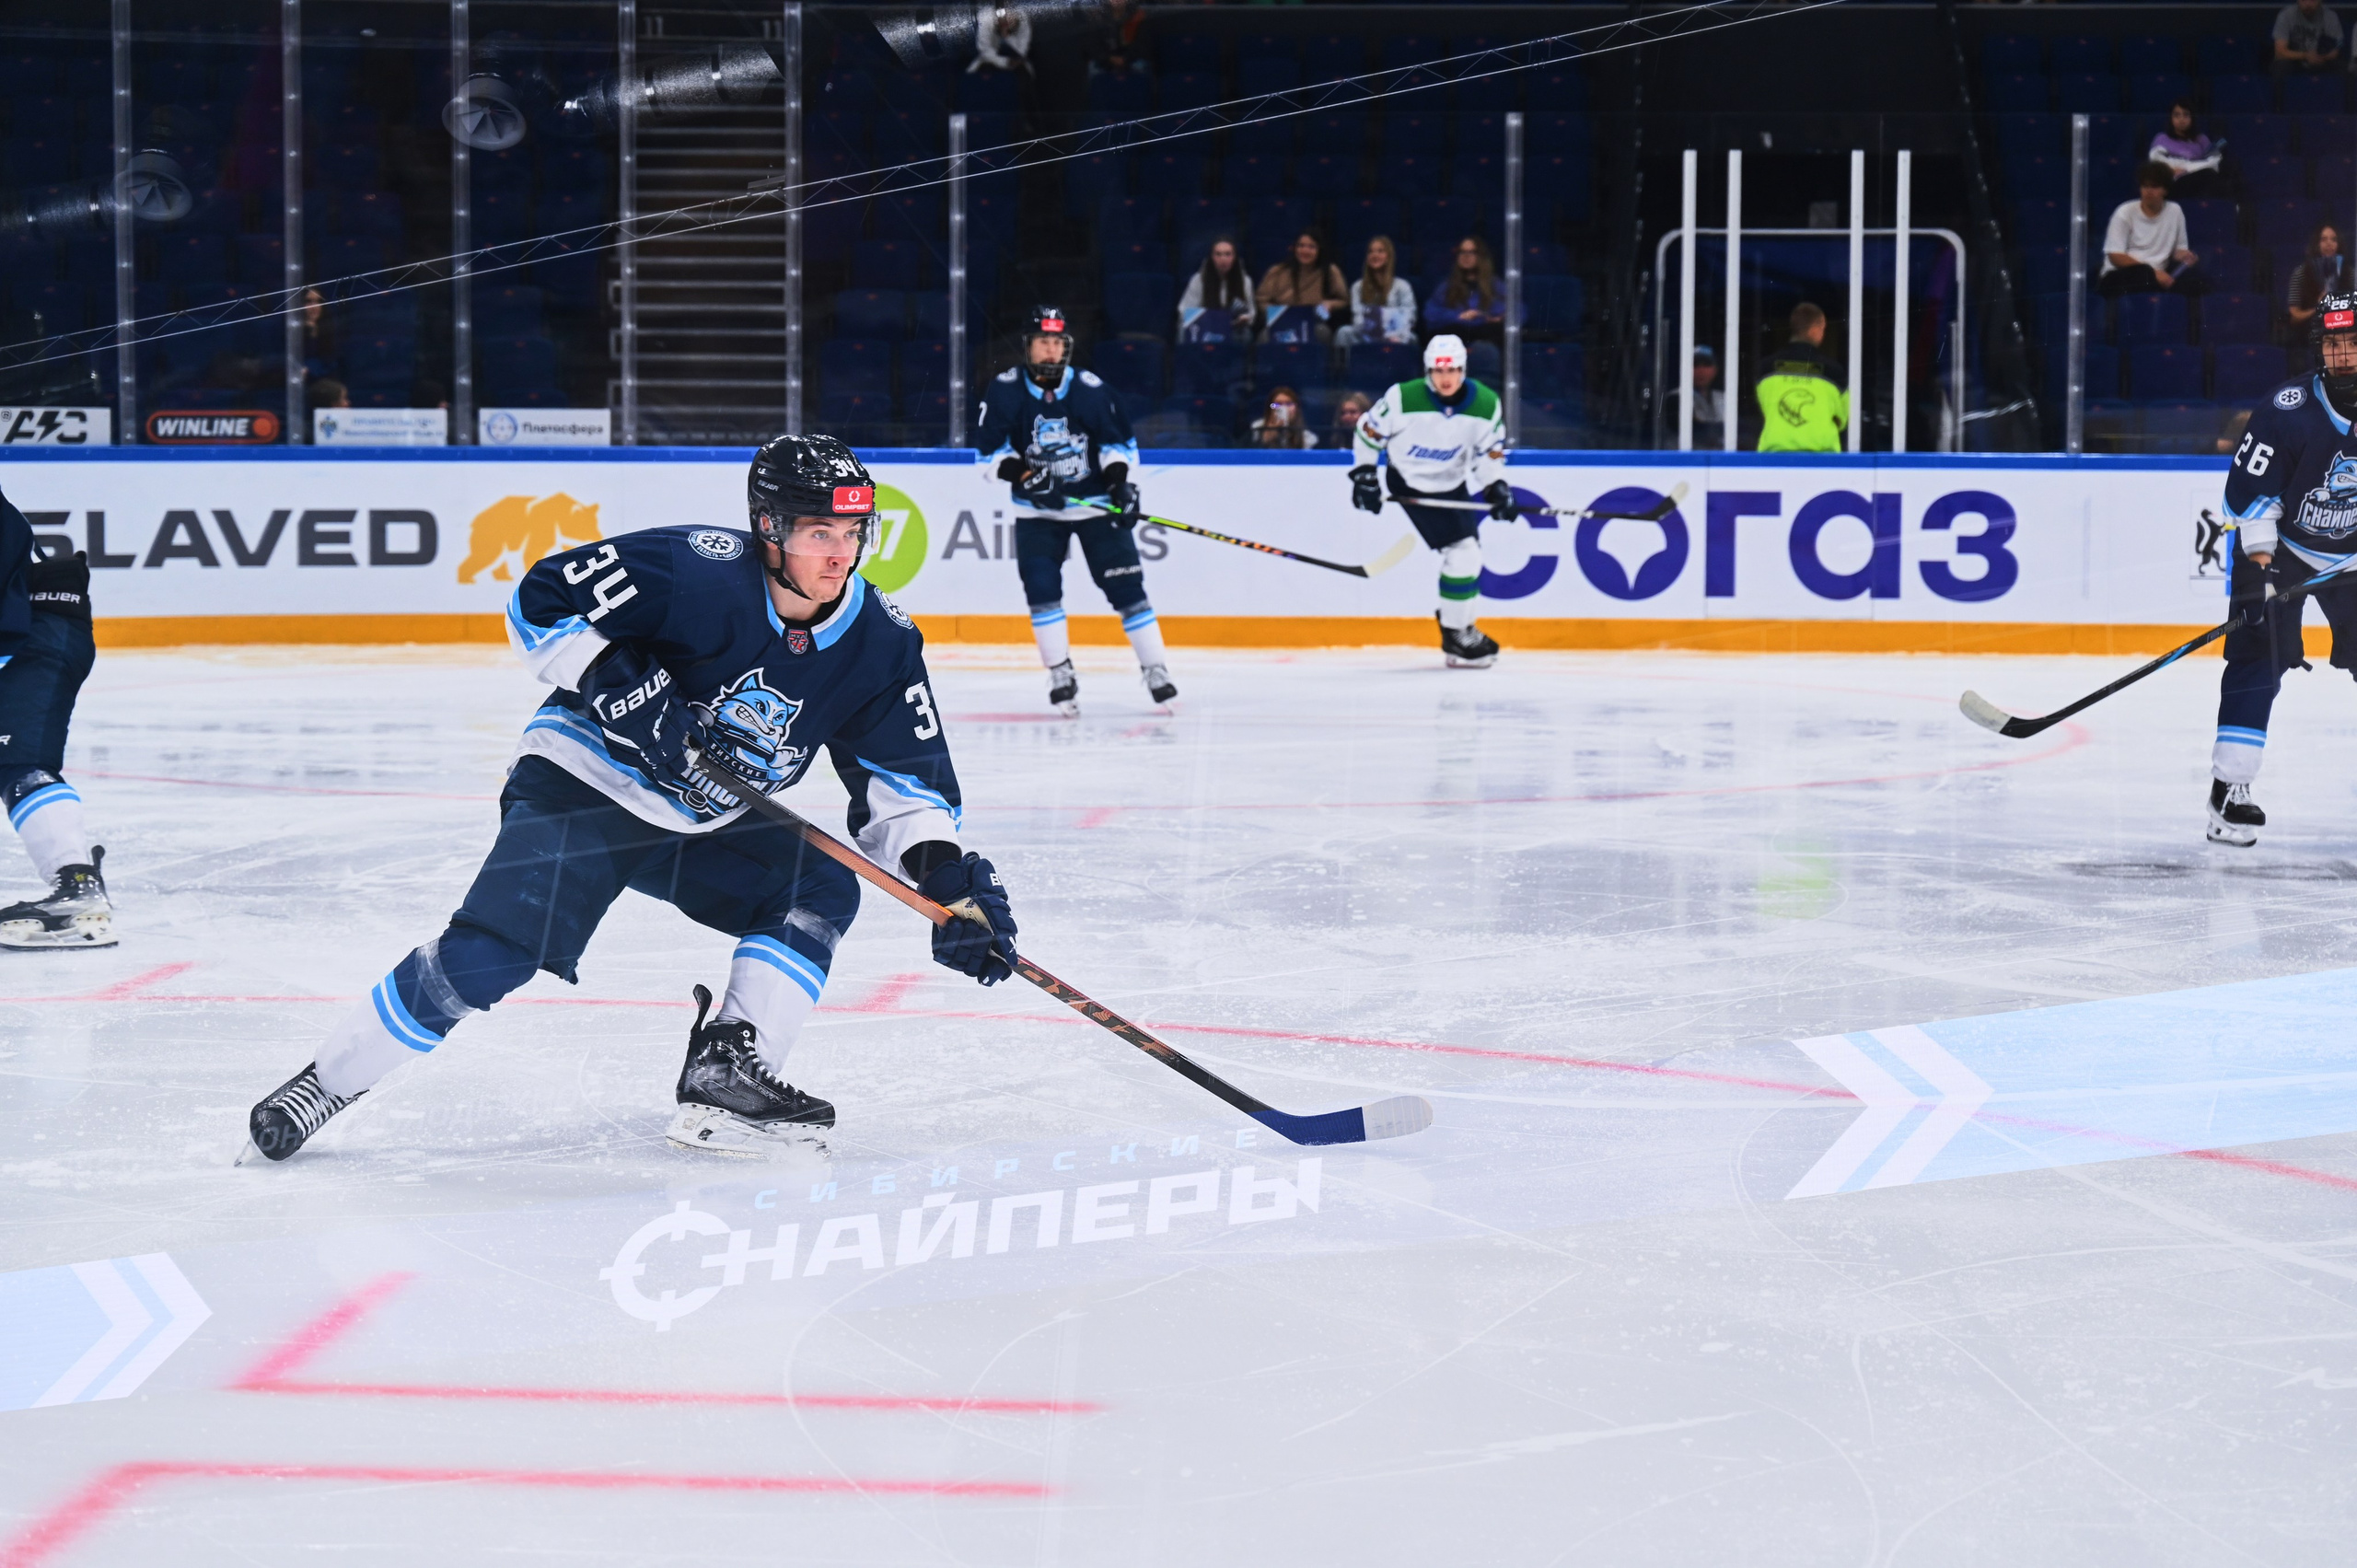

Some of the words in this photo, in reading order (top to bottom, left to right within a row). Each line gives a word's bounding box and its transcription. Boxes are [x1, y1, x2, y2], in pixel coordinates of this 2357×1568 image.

[2330, 299, 2349, 310] 26
[157, 417, 250, 437] WINLINE
[829, 459, 861, 478] 34
[2234, 432, 2275, 477] 26
[563, 543, 639, 623] 34
[610, 668, 672, 720] BAUE
[709, 742, 762, 779] БИРСКИЕ
[1012, 962, 1155, 1050] OYUZ
[754, 1127, 1260, 1211] СИБИРСКИЕ
[599, 1156, 1323, 1332] СНАЙПЕРЫ
